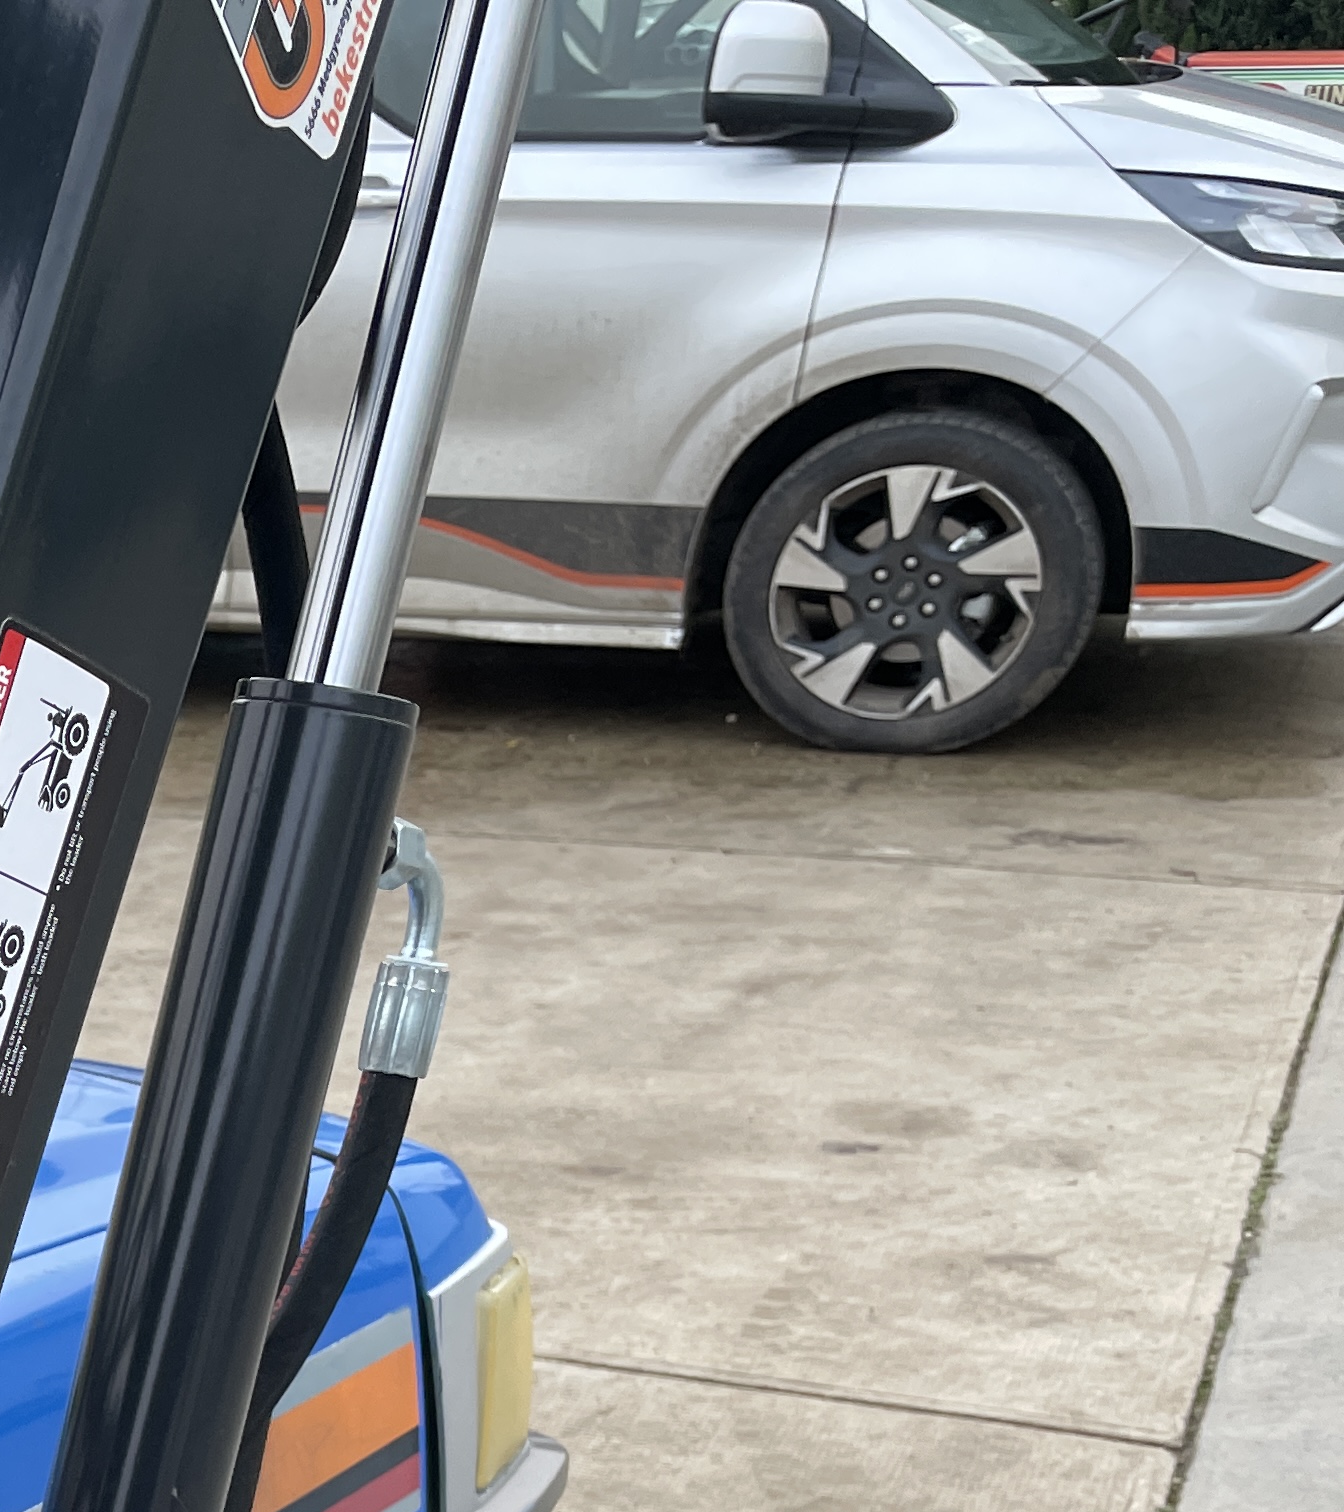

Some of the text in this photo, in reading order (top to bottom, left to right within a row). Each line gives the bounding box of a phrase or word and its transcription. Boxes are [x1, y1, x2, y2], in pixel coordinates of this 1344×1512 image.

[304, 97, 321, 139] 5666
[57, 866, 67, 883] Do
[62, 849, 73, 867] not
[77, 771, 97, 819] transport
[91, 736, 108, 771] people
[102, 707, 118, 737] using
[63, 867, 74, 885] the
[0, 1065, 13, 1094] stand
